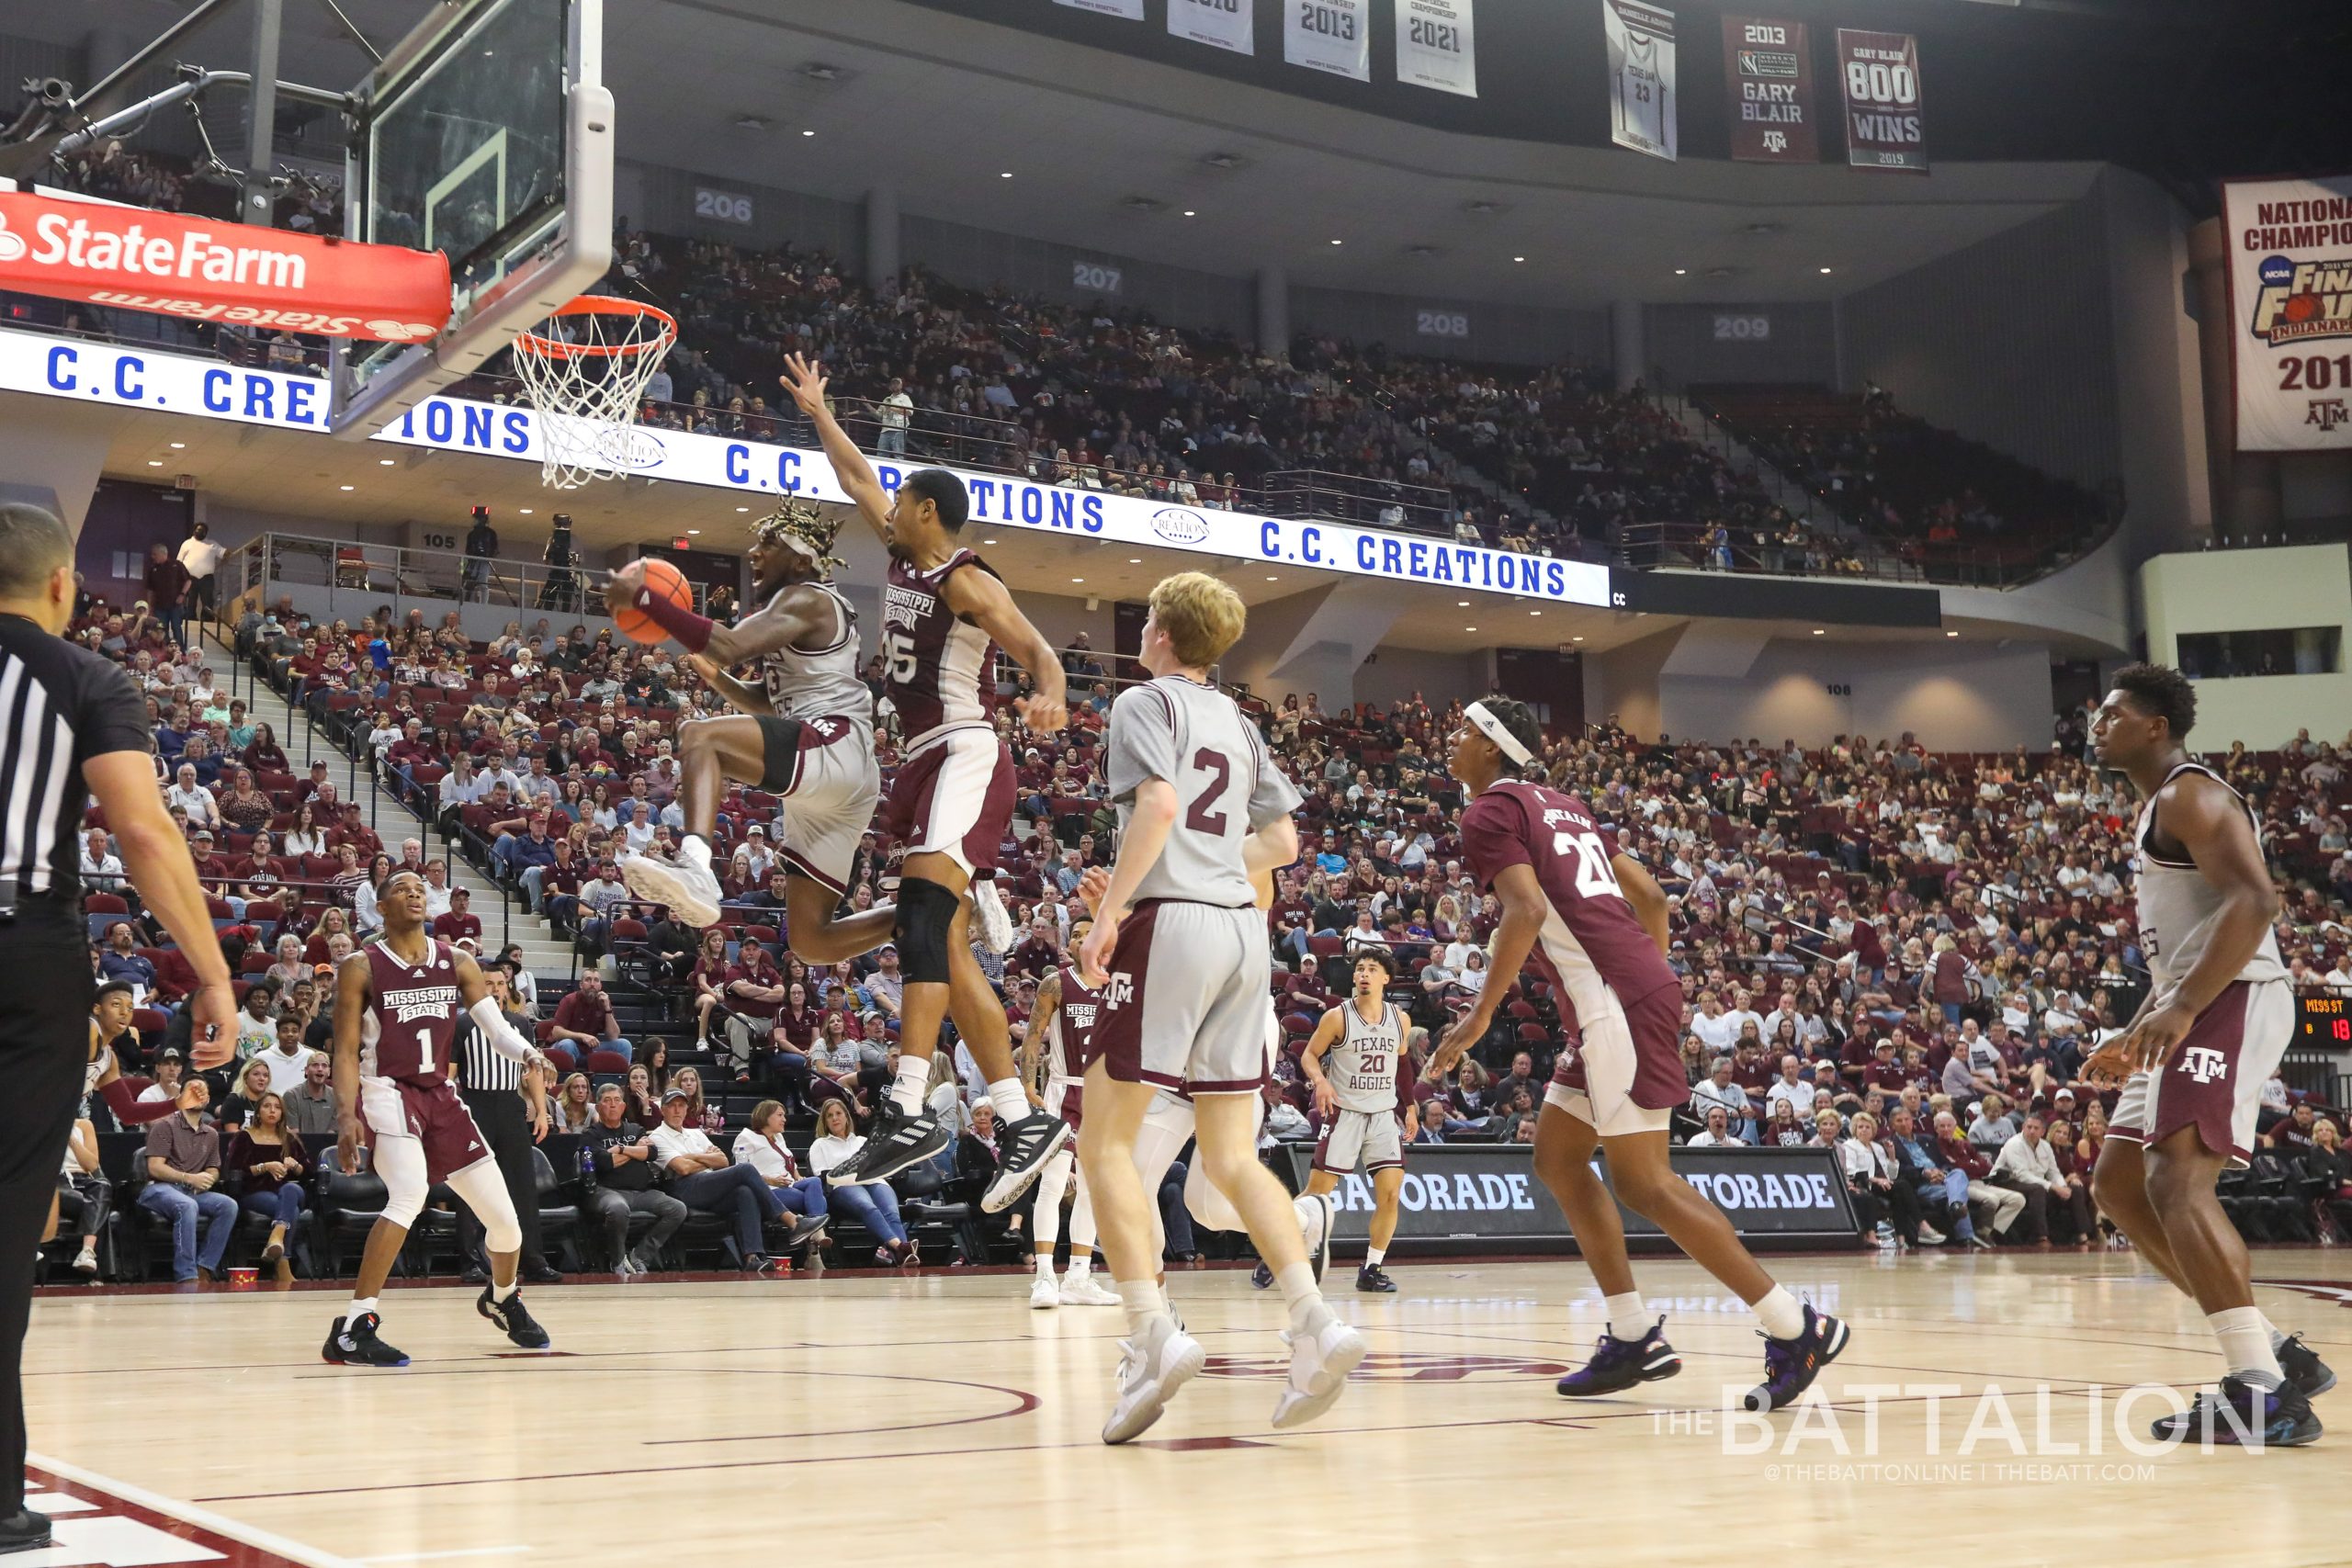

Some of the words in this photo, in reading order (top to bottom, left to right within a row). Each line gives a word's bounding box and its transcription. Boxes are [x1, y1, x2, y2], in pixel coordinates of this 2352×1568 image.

[1301, 2, 1355, 41] 2013
[1410, 16, 1461, 53] 2021
[1745, 25, 1786, 44] 2013
[1853, 47, 1877, 59] GARY
[1878, 48, 1905, 62] BLAIR
[1847, 61, 1917, 104] 800
[1635, 83, 1650, 103] 23
[1743, 82, 1796, 104] GARY
[1740, 101, 1803, 124] BLAIR
[1852, 112, 1921, 143] WINS
[1879, 152, 1905, 164] 2019
[695, 191, 752, 221] 206
[1073, 264, 1121, 291] 207
[2264, 270, 2291, 279] NCAA
[1417, 312, 1468, 335] 208
[1713, 317, 1770, 338] 209
[1150, 518, 1211, 536] CREATIONS
[423, 534, 456, 549] 105
[1261, 521, 1336, 566] C.C.
[1356, 535, 1566, 596] CREATIONS
[1612, 592, 1626, 606] CC
[888, 606, 910, 624] STATE
[1185, 746, 1230, 838] 2
[1553, 831, 1624, 899] 20
[382, 988, 458, 1007] MISSISSIPPI
[2306, 999, 2330, 1014] MISS
[2330, 999, 2344, 1013] ST
[406, 1004, 442, 1019] STATE
[415, 1028, 436, 1075] 1
[1352, 1037, 1395, 1054] TEXAS
[1359, 1054, 1385, 1074] 20
[1349, 1076, 1392, 1090] AGGIES
[1329, 1173, 1535, 1212] AORADE
